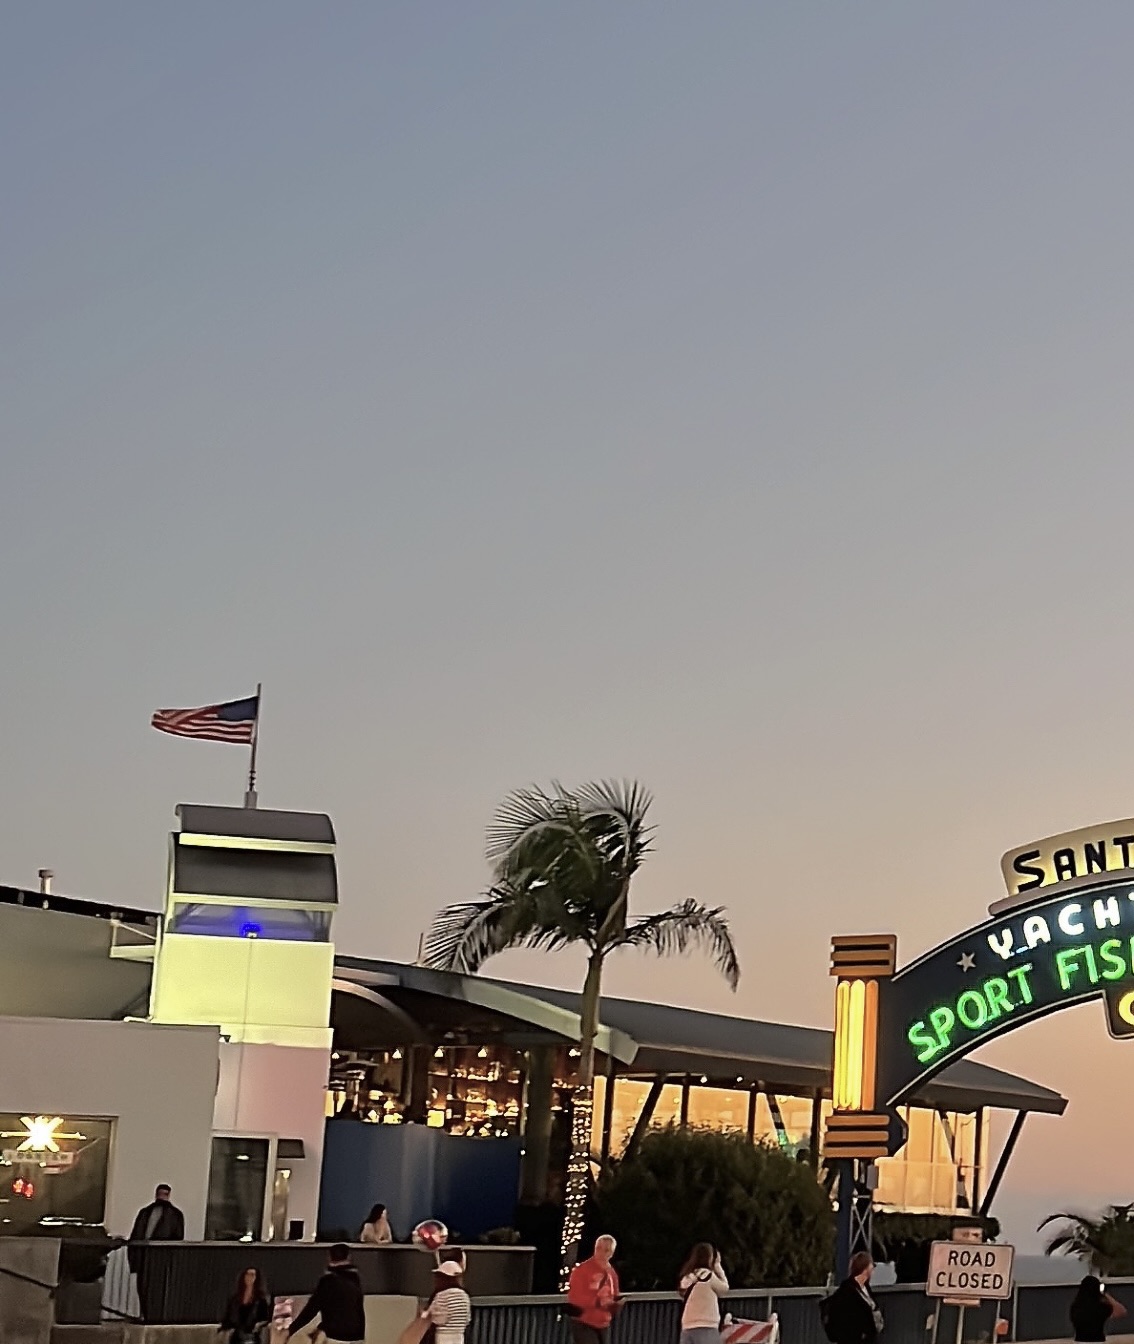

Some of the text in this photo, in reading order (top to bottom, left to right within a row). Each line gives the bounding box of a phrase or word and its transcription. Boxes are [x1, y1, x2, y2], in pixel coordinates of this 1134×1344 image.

[908, 963, 1033, 1063] SPORT
[948, 1250, 996, 1267] ROAD
[936, 1271, 1004, 1290] CLOSED
